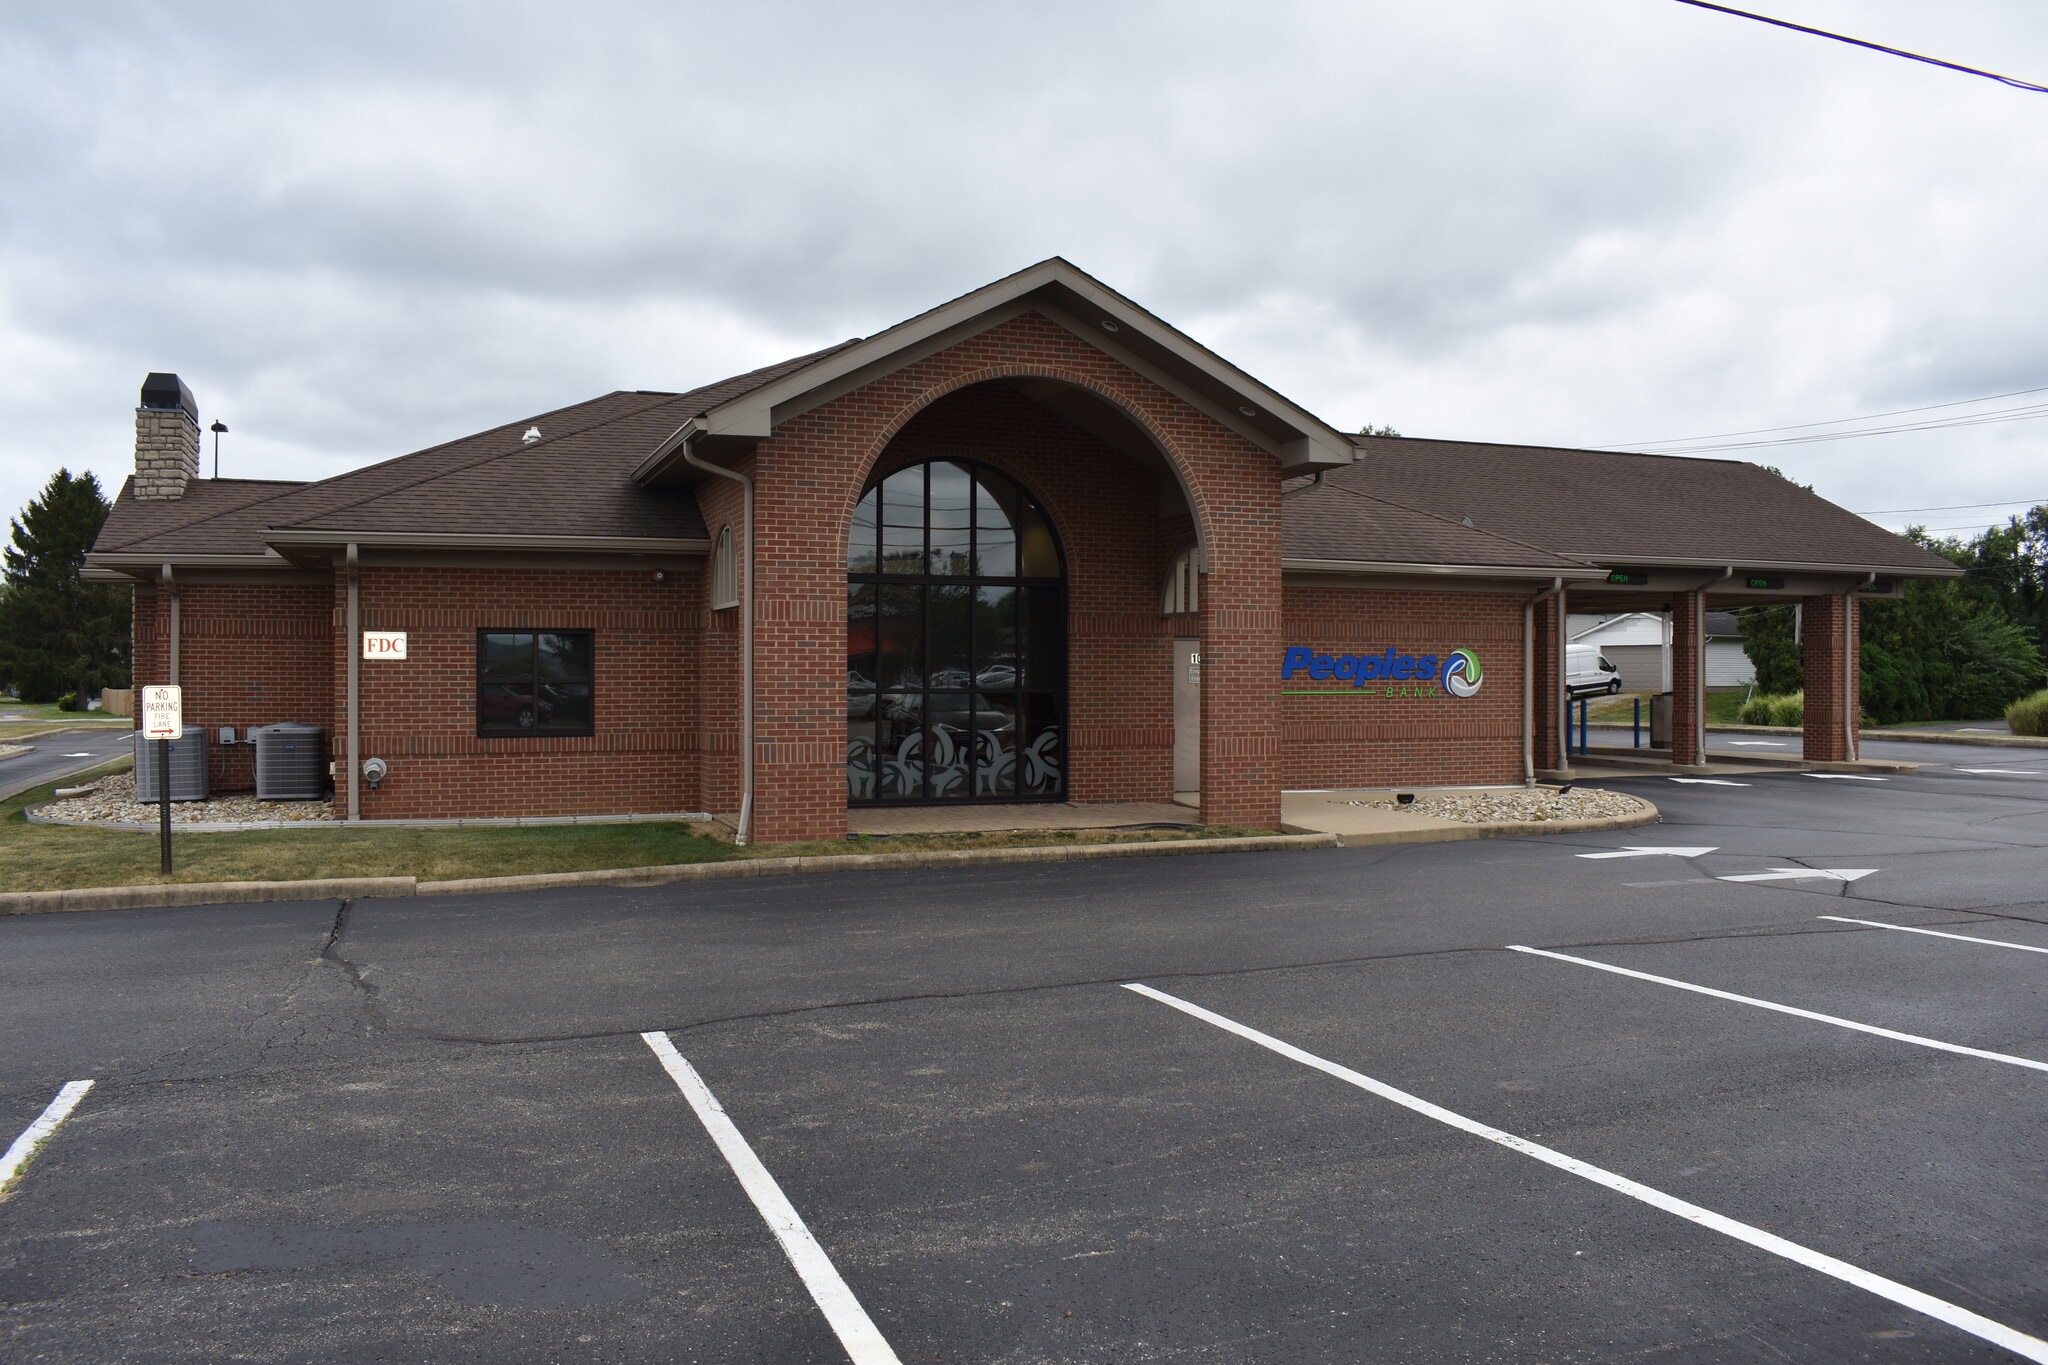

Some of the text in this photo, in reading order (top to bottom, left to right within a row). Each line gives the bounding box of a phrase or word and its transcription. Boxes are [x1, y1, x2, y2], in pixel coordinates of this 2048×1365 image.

[1611, 574, 1628, 582] OPEN
[1751, 579, 1766, 587] OPEN
[367, 638, 404, 653] FDC
[1281, 646, 1438, 687] Peoples
[155, 690, 169, 701] NO
[1385, 686, 1437, 698] BANK
[146, 702, 178, 712] PARKING
[154, 712, 170, 720] FIRE
[153, 720, 171, 728] LANE
